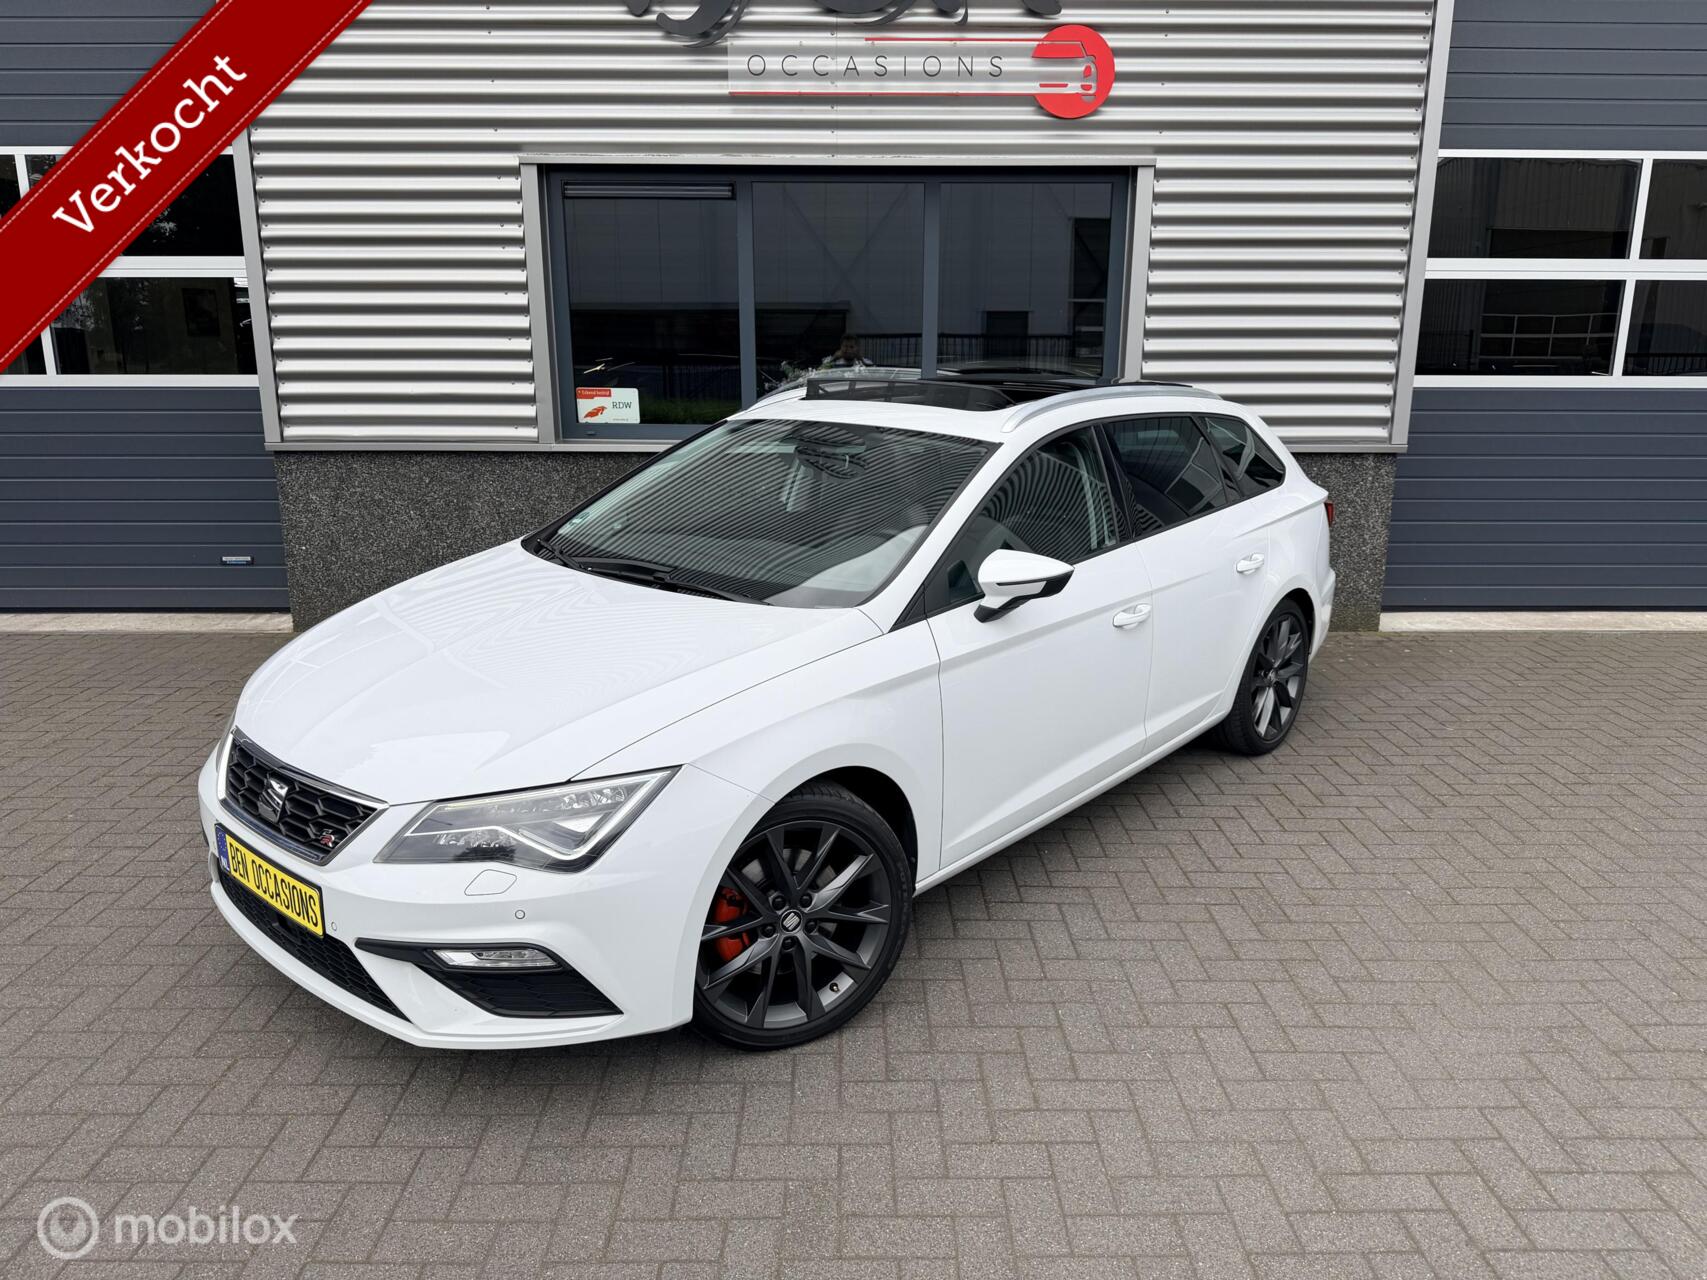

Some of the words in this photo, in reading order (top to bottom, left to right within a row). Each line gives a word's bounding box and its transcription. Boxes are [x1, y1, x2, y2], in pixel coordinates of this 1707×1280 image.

[746, 54, 1004, 79] OCCASIONS
[612, 401, 632, 409] RDW
[230, 842, 250, 883] BEN
[251, 858, 319, 928] OCCASIONS
